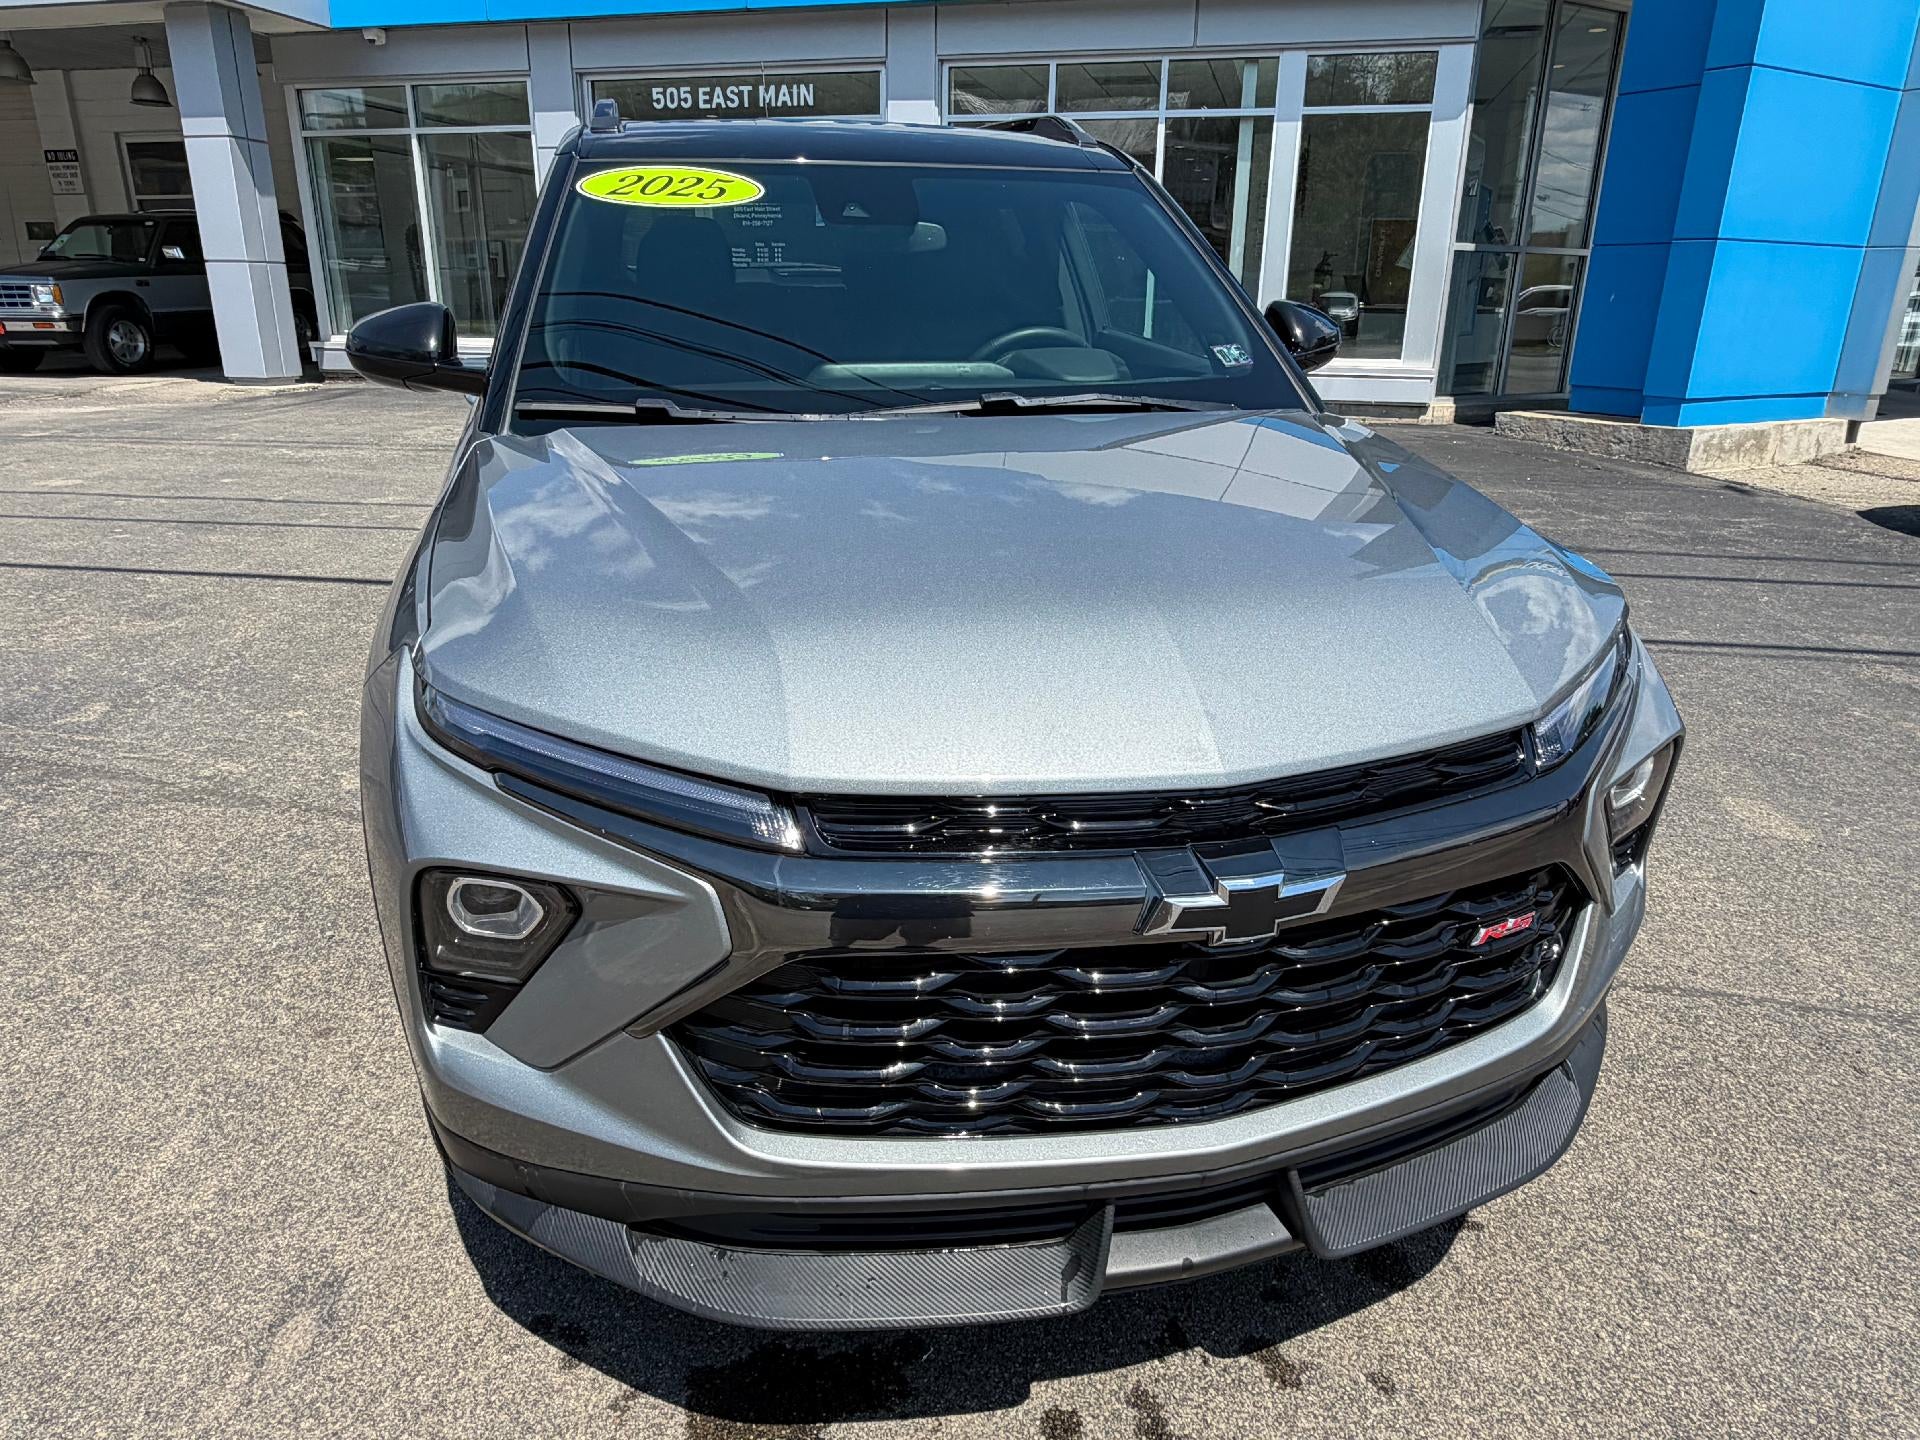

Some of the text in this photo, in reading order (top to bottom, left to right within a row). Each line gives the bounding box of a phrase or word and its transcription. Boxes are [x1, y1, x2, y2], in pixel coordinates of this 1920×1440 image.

[651, 83, 815, 110] 505 EAST MAIN
[606, 174, 736, 200] 2025
[1470, 911, 1537, 946] RS
